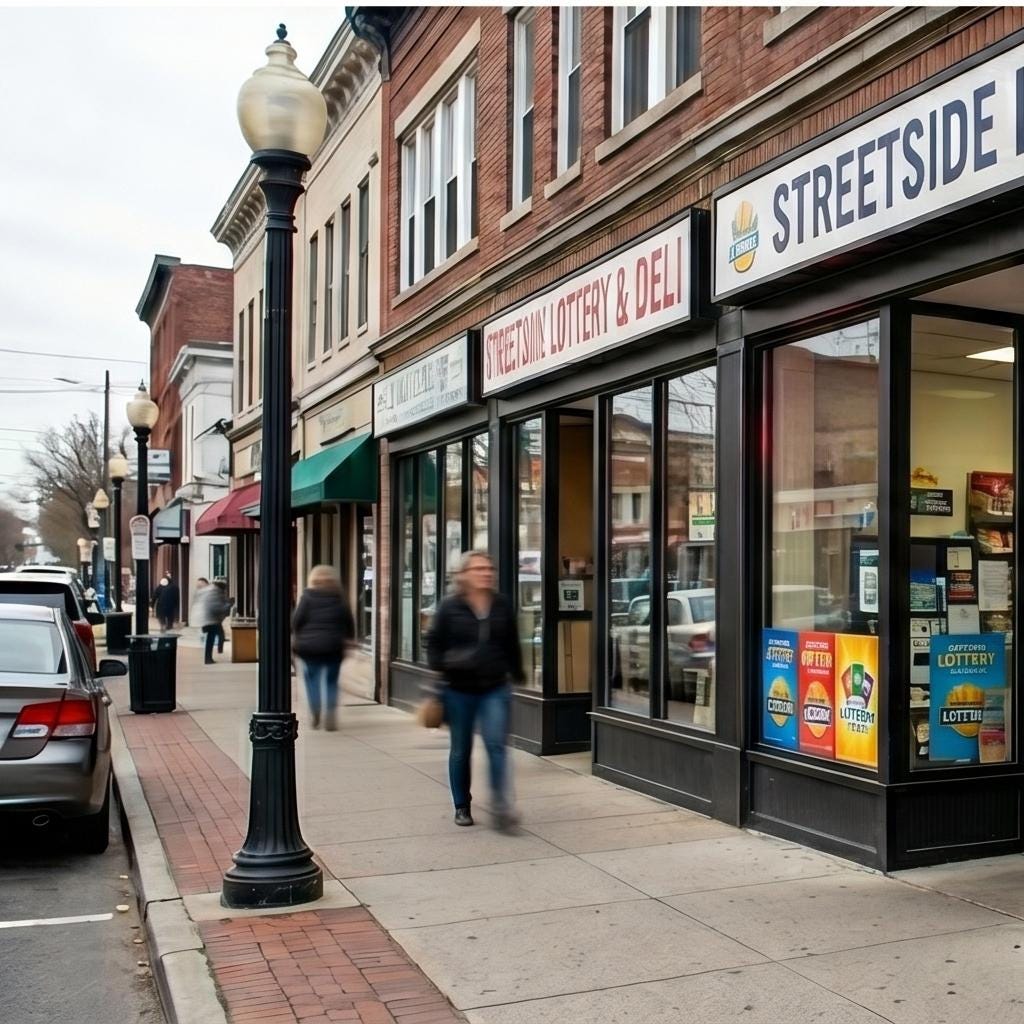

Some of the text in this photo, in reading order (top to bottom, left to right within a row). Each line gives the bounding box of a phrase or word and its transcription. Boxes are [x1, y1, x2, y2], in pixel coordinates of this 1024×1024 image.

[772, 81, 997, 254] STREETSIDE
[550, 272, 612, 355] LOTTERY
[616, 267, 629, 327] &
[636, 236, 682, 320] DELI
[937, 652, 996, 668] LOTTERY
